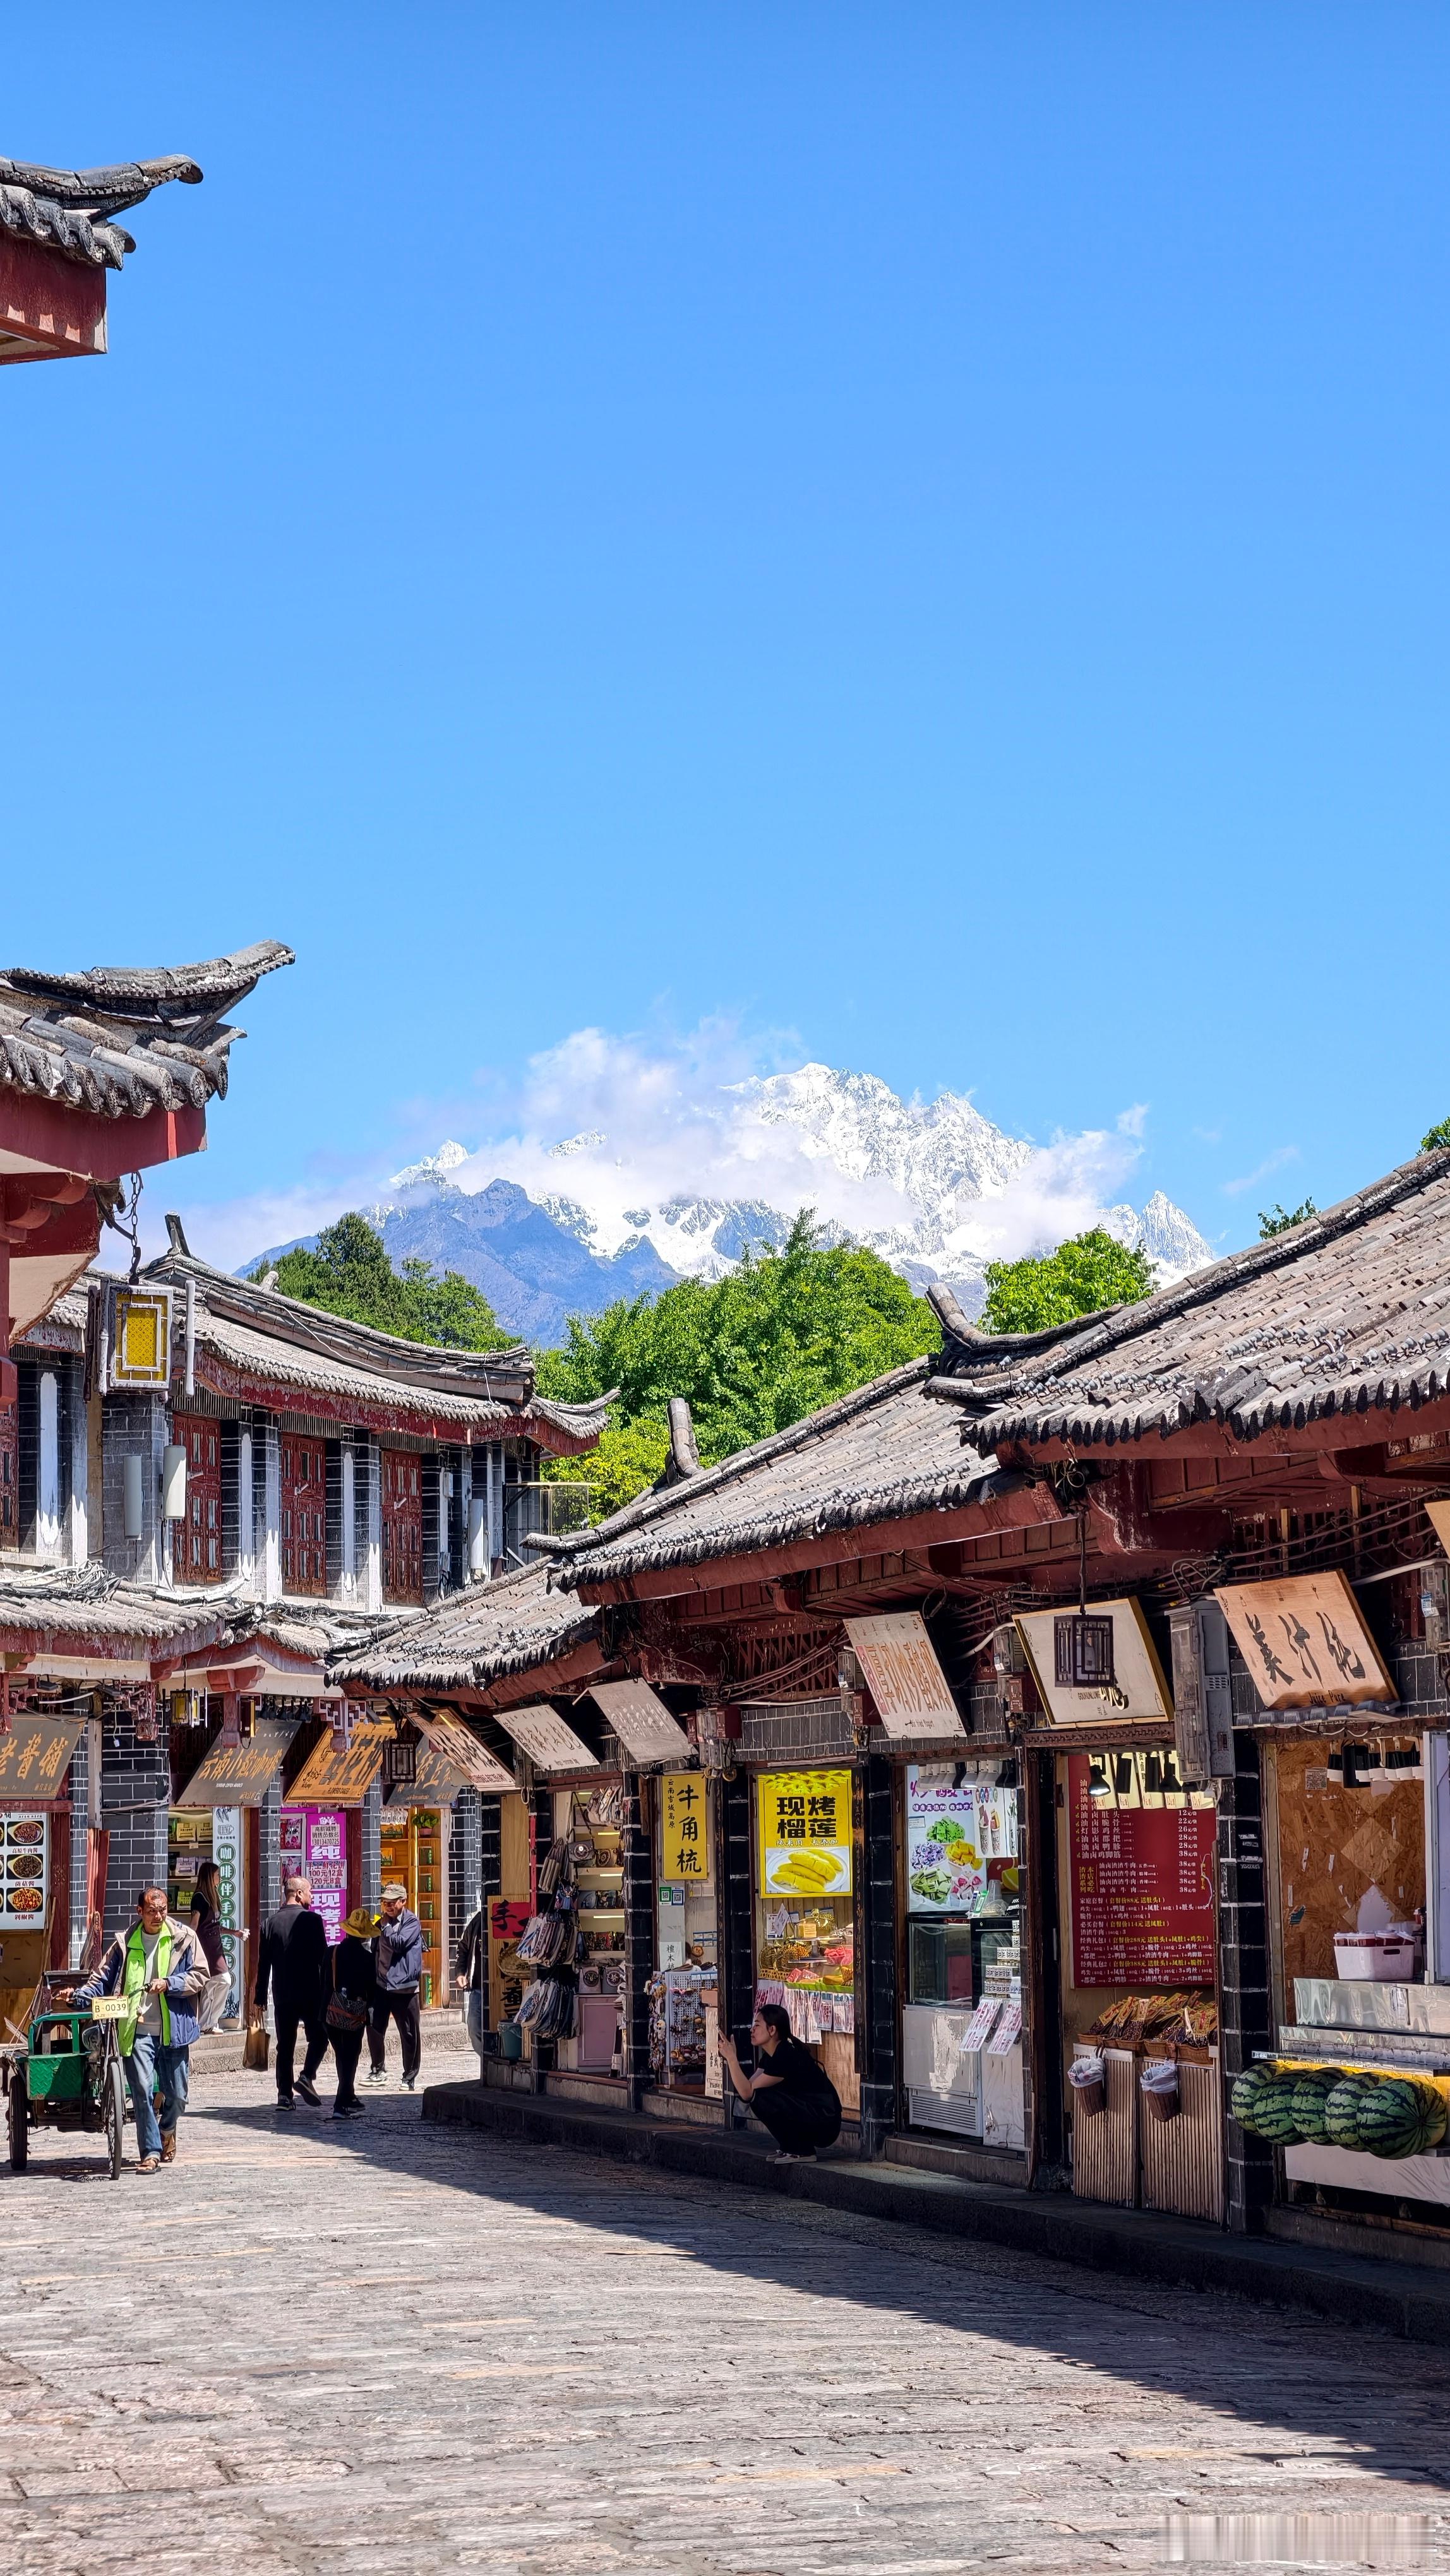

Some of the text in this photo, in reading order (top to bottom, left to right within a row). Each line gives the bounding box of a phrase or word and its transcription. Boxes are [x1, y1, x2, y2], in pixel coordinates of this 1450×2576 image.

[1309, 1690, 1345, 1705] Juice Pure
[198, 1748, 283, 1780] 云南小粒咖啡
[777, 1796, 836, 1816] 现烤
[676, 1784, 702, 1873] 牛角梳
[777, 1818, 837, 1839] 榴莲
[311, 1846, 341, 1859] 纯
